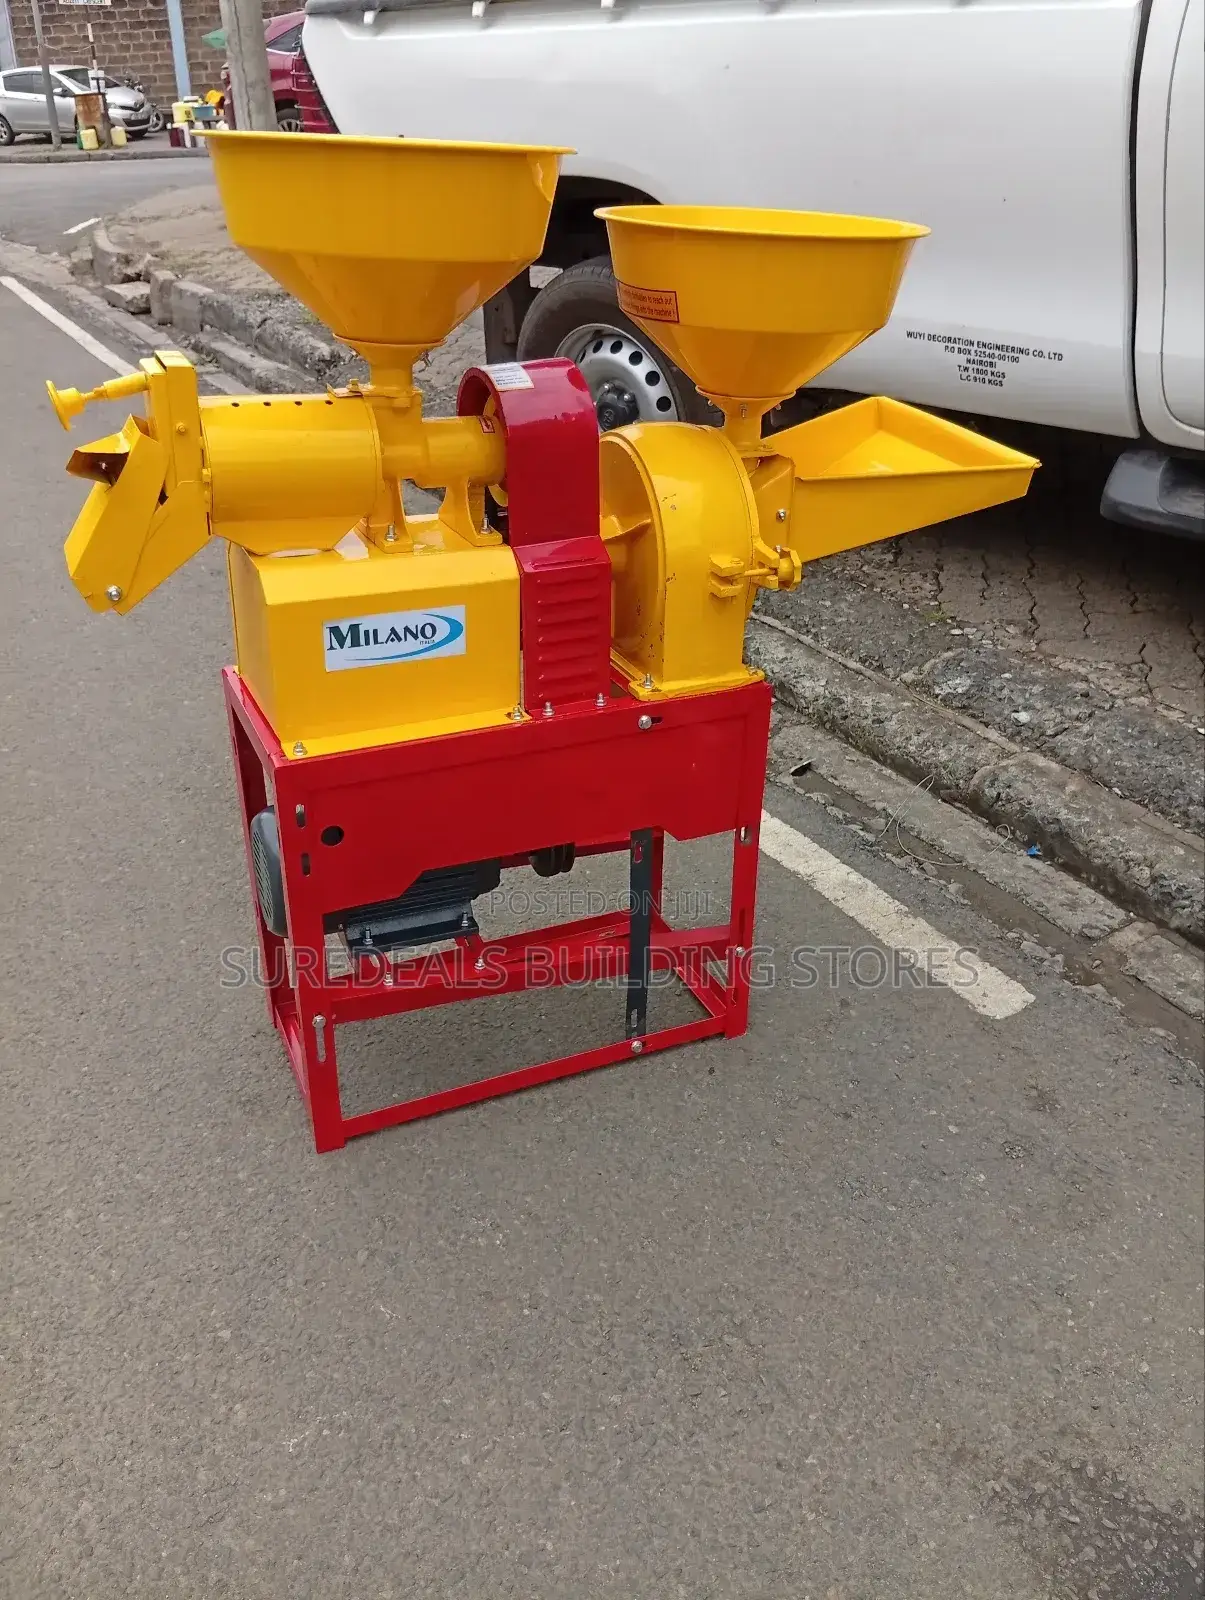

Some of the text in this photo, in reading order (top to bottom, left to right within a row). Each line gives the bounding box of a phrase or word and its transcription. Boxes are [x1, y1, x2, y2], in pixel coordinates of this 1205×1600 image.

[906, 330, 1064, 361] WUYI DECORATION ENGINEERING CO. LTD
[957, 346, 972, 356] BOX
[973, 348, 1020, 363] 52540-00100
[966, 357, 997, 369] NAIROBI
[971, 367, 988, 376] 1800
[990, 370, 1006, 379] KGS
[973, 375, 986, 384] 910
[988, 378, 1004, 387] KGS
[326, 622, 437, 651] MILANO
